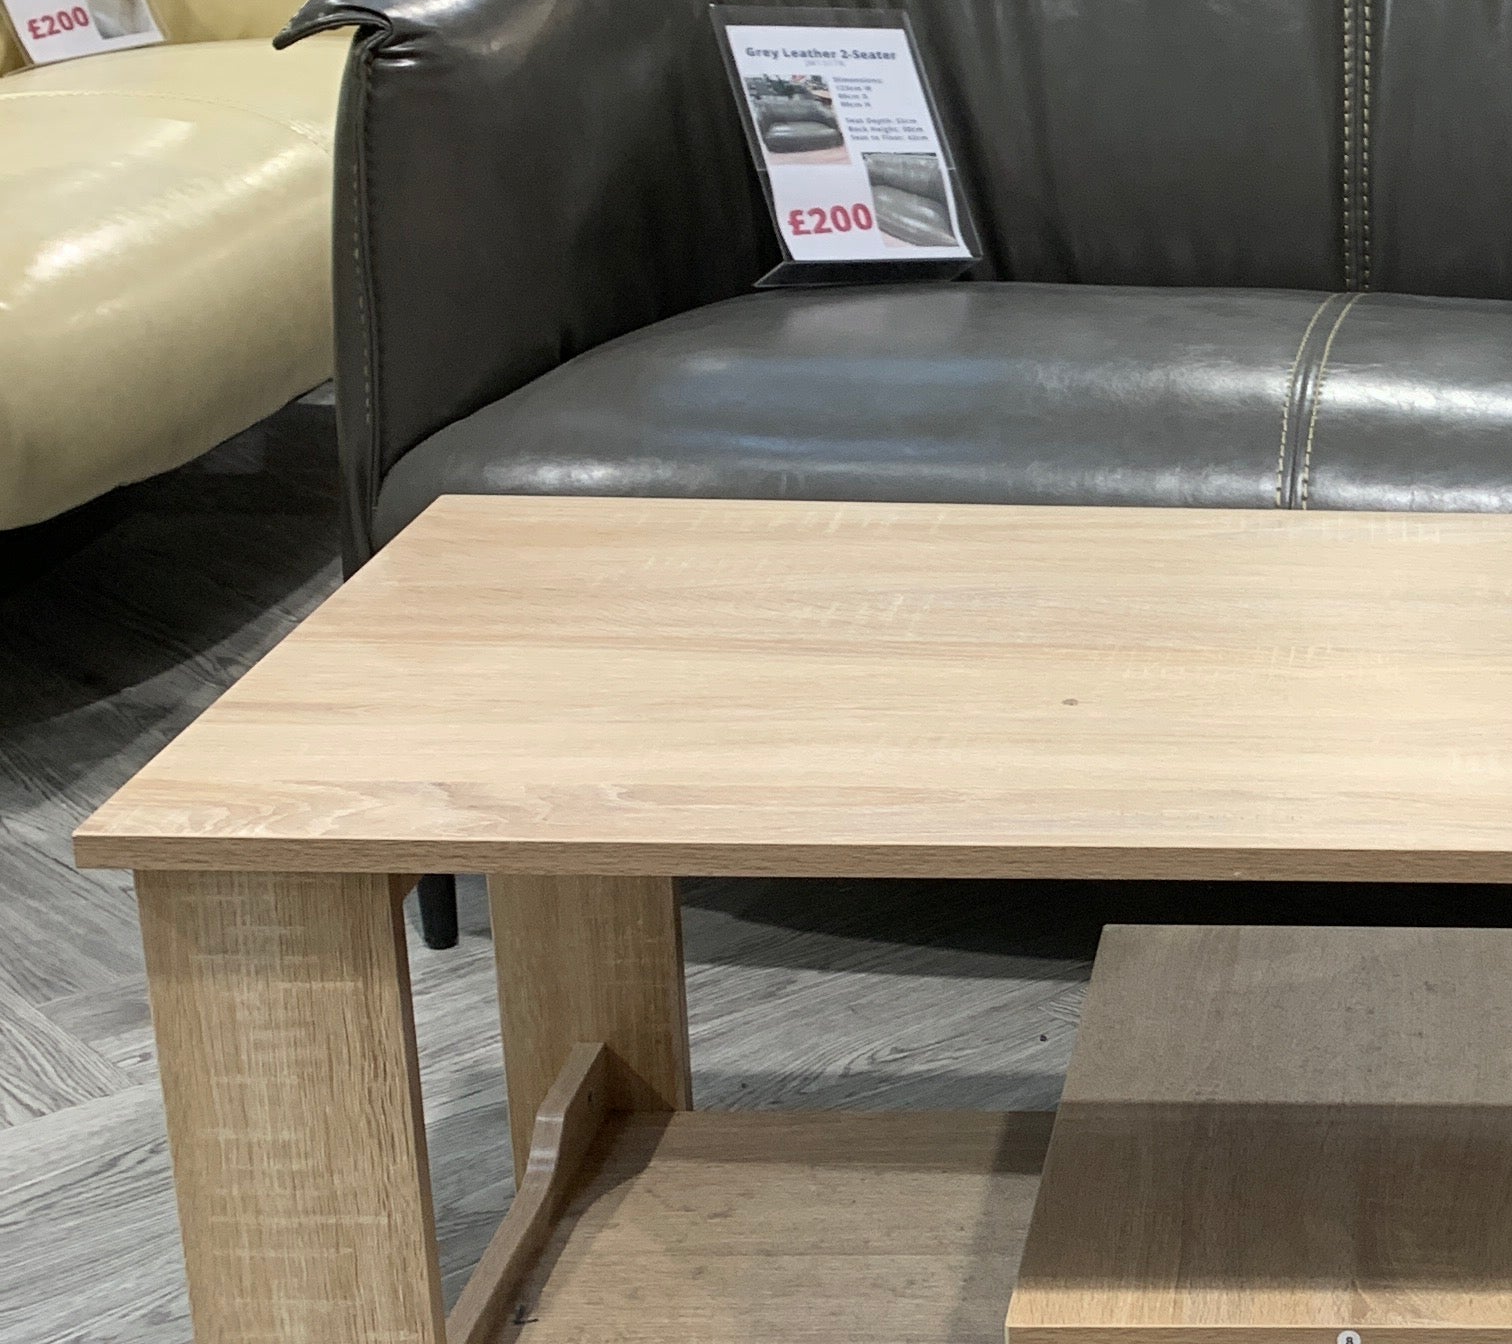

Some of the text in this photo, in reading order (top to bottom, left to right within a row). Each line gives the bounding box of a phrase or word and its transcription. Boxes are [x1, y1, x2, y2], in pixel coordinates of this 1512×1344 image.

[27, 6, 90, 40] £200
[745, 47, 896, 61] Grey Leather 2-Seater
[788, 203, 873, 235] £200
